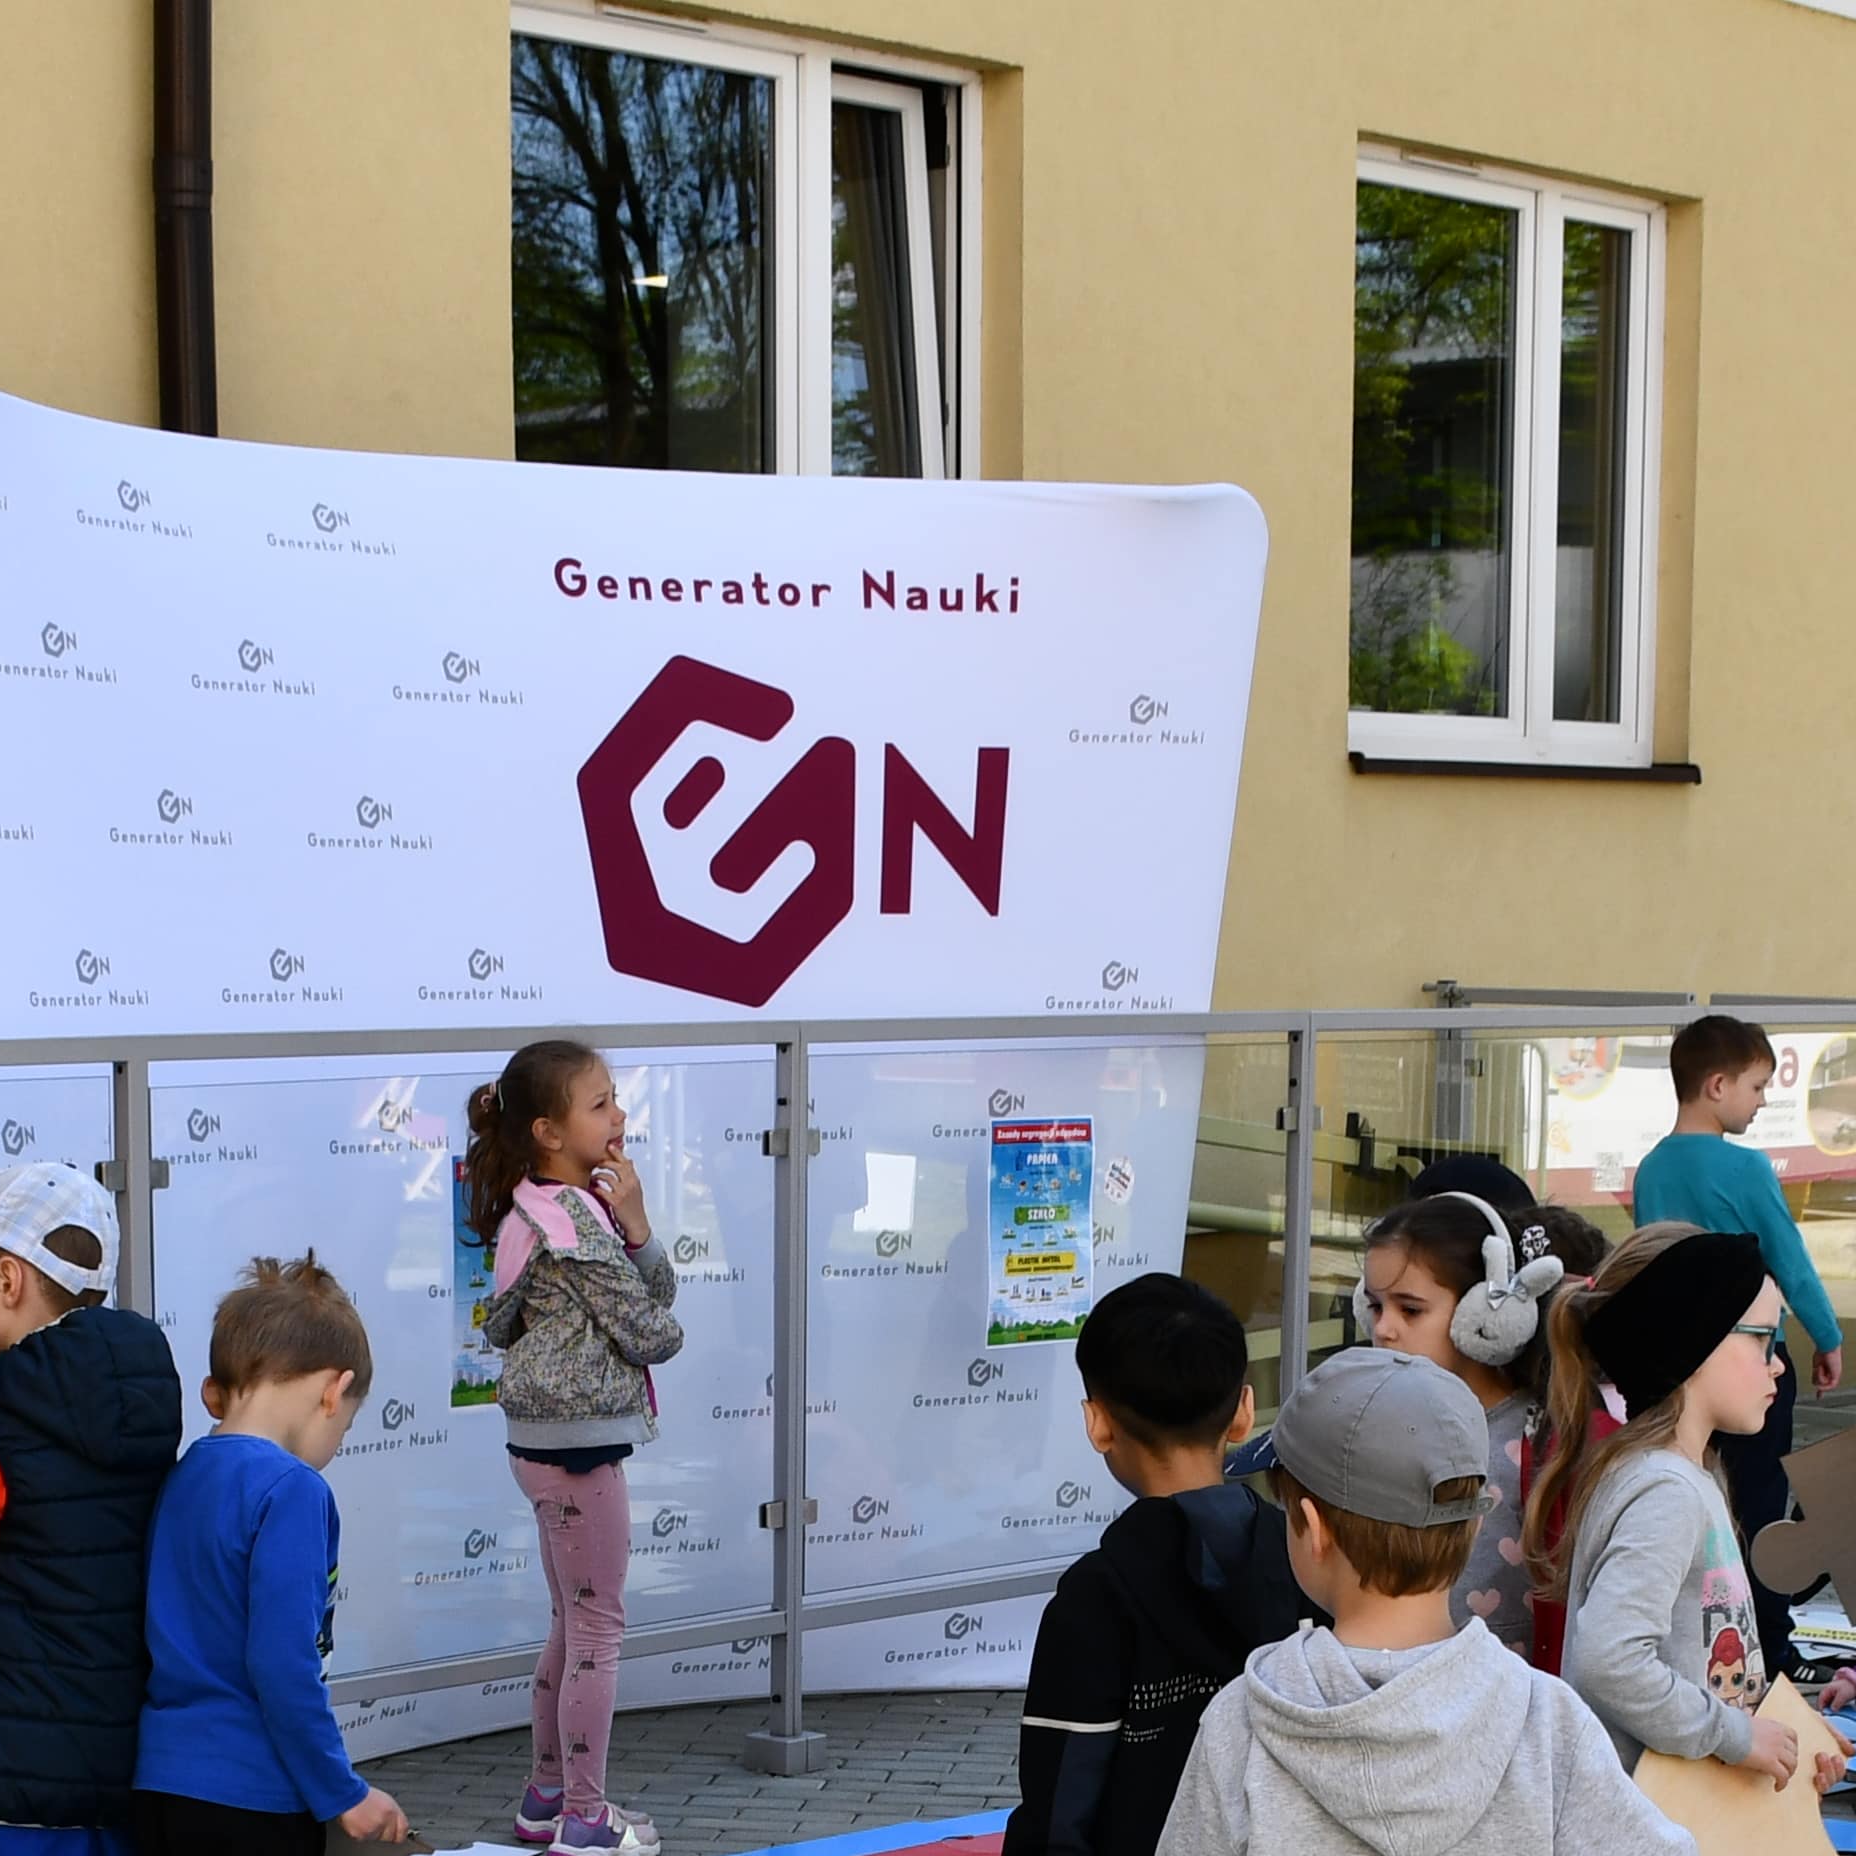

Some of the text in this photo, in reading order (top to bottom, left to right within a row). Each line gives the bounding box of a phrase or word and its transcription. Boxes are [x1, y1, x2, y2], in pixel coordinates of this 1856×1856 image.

[76, 508, 193, 540] Generator Nauki
[266, 531, 397, 556] Generator Nauki
[554, 557, 1021, 614] Generator Nauki
[75, 664, 118, 685] Nauki
[190, 673, 316, 697] Generator Nauki
[392, 684, 524, 705] Generator Nauki
[1068, 728, 1205, 745] Generator Nauki
[109, 827, 233, 846] Generator Nauki
[307, 831, 433, 851] Generator Nauki
[28, 988, 149, 1008] Generator Nauki
[221, 985, 344, 1004] Generator Nauki
[417, 984, 543, 1001] Generator Nauki
[1045, 994, 1174, 1010] Generator Nauki
[624, 1131, 648, 1144] uki
[820, 1127, 853, 1141] auki
[932, 1124, 987, 1139] Genera
[158, 1145, 258, 1166] erator Nauki
[328, 1135, 450, 1156] Generator Nauki
[820, 1259, 949, 1278] Generator Nauki
[1107, 1252, 1149, 1267] Nauki
[703, 1268, 745, 1283] Nauki
[912, 1387, 1039, 1409] Generator Nauki
[711, 1400, 837, 1420] Generat auki
[1001, 1512, 1077, 1529] Generator
[808, 1523, 925, 1545] enerator Nauki
[677, 1538, 721, 1554] Nauki
[413, 1555, 528, 1587] Generator Nauki
[884, 1637, 1023, 1664] Generator Nauki
[671, 1660, 752, 1675] Generator
[482, 1680, 530, 1696] Genera
[380, 1699, 417, 1721] Nauki
